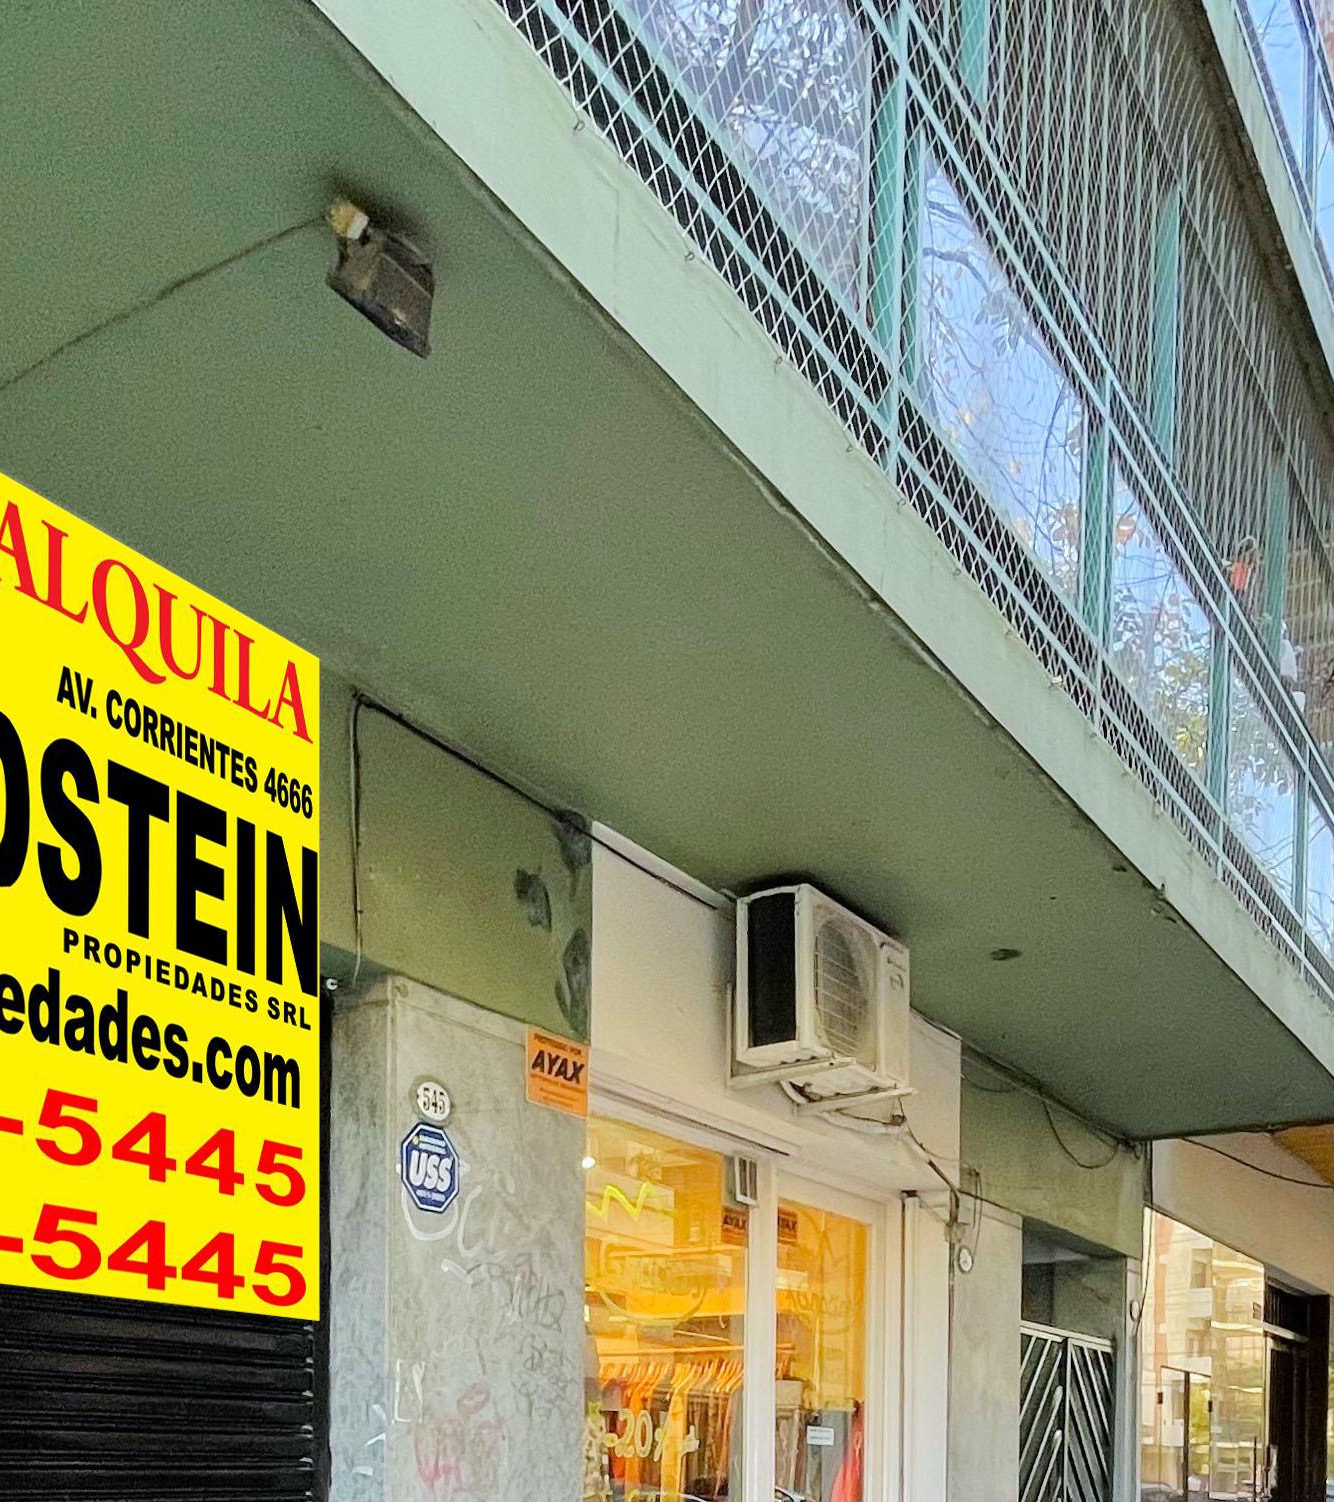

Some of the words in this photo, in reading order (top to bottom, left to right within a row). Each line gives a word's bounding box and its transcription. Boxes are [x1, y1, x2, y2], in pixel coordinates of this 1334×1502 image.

[56, 665, 98, 720] AV.
[105, 689, 258, 794] CORRIENTES
[264, 767, 313, 820] 4666
[63, 927, 259, 1014] PROPIEDADES
[267, 996, 313, 1031] SRL
[531, 1049, 585, 1085] AYAX
[409, 1149, 454, 1193] USS
